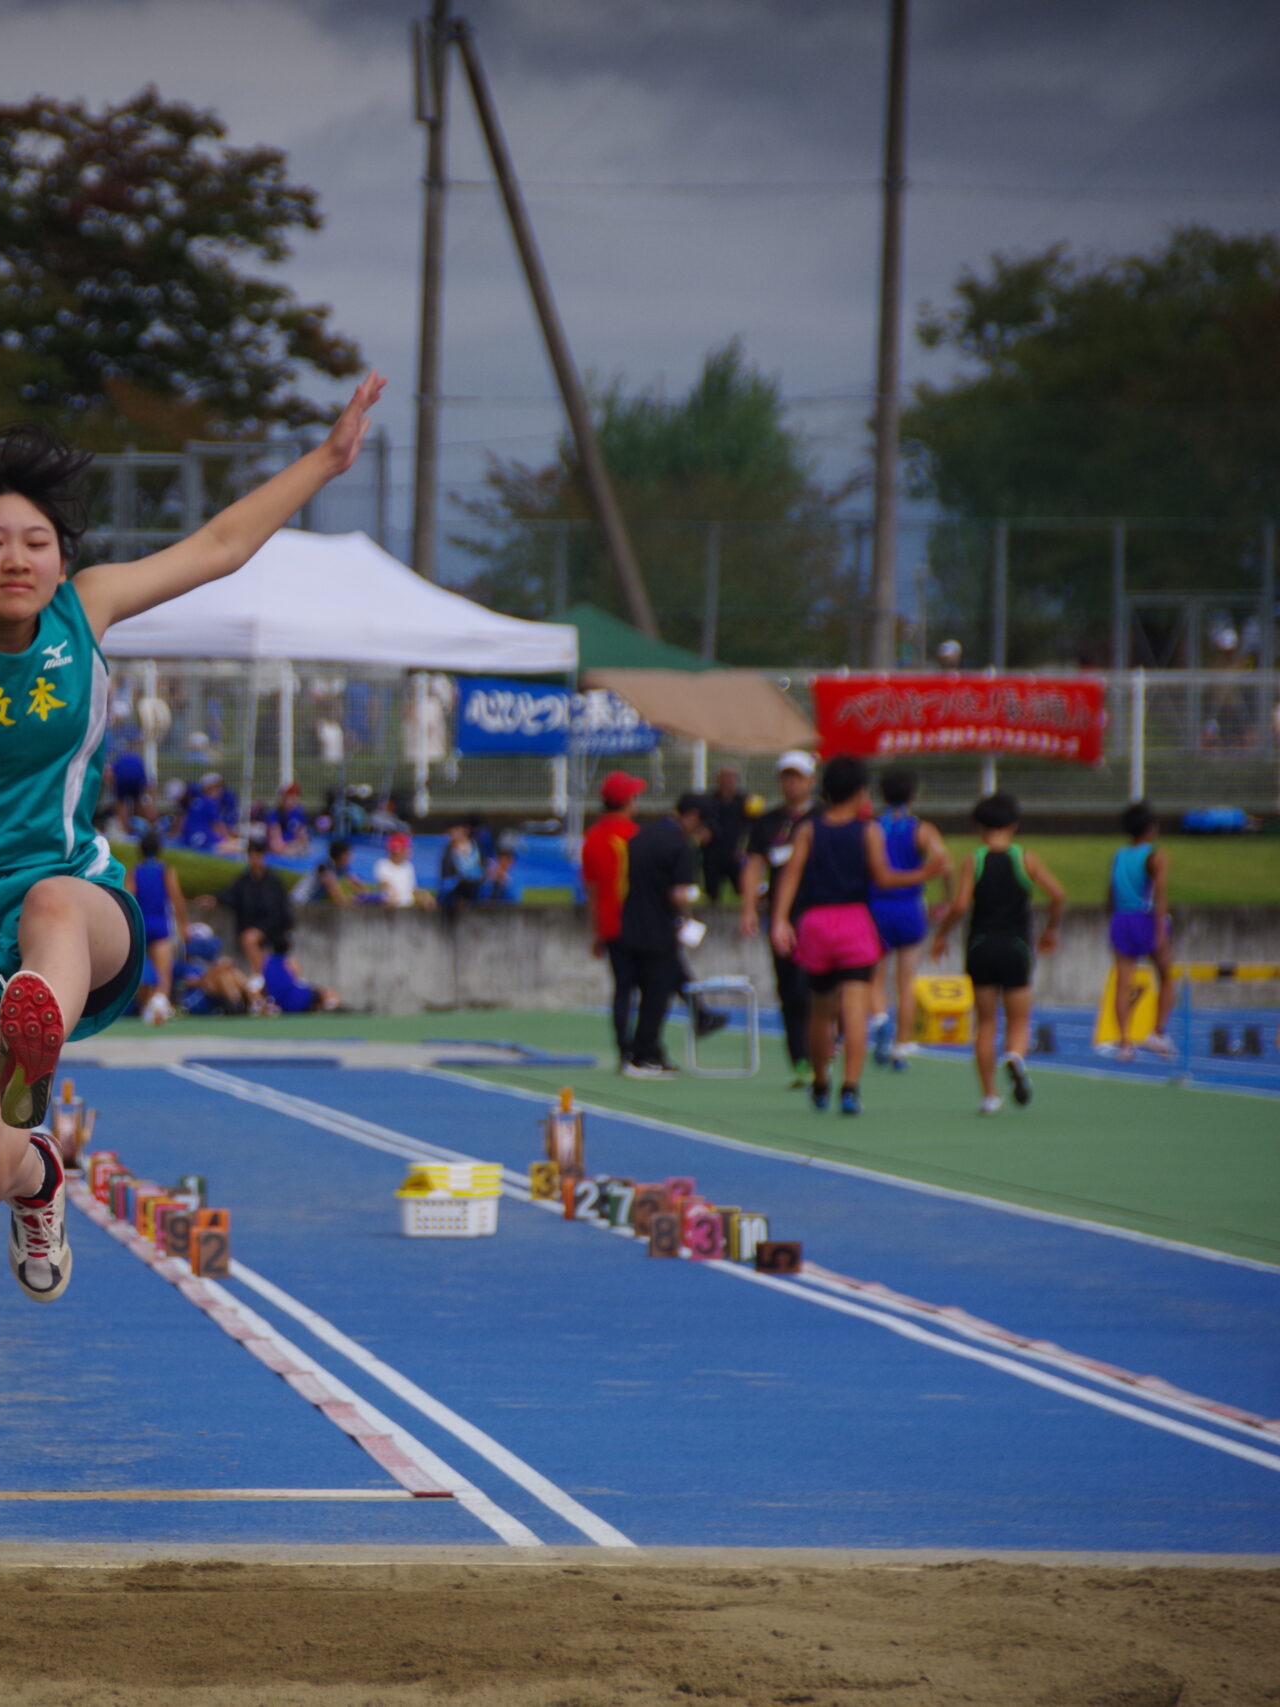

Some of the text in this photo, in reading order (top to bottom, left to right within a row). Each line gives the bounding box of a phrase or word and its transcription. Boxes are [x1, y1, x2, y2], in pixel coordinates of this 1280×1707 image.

[576, 1181, 600, 1218] 2
[609, 1185, 635, 1225] 7
[655, 1216, 678, 1252] 8
[694, 1218, 716, 1255] 3
[201, 1233, 227, 1275] 2
